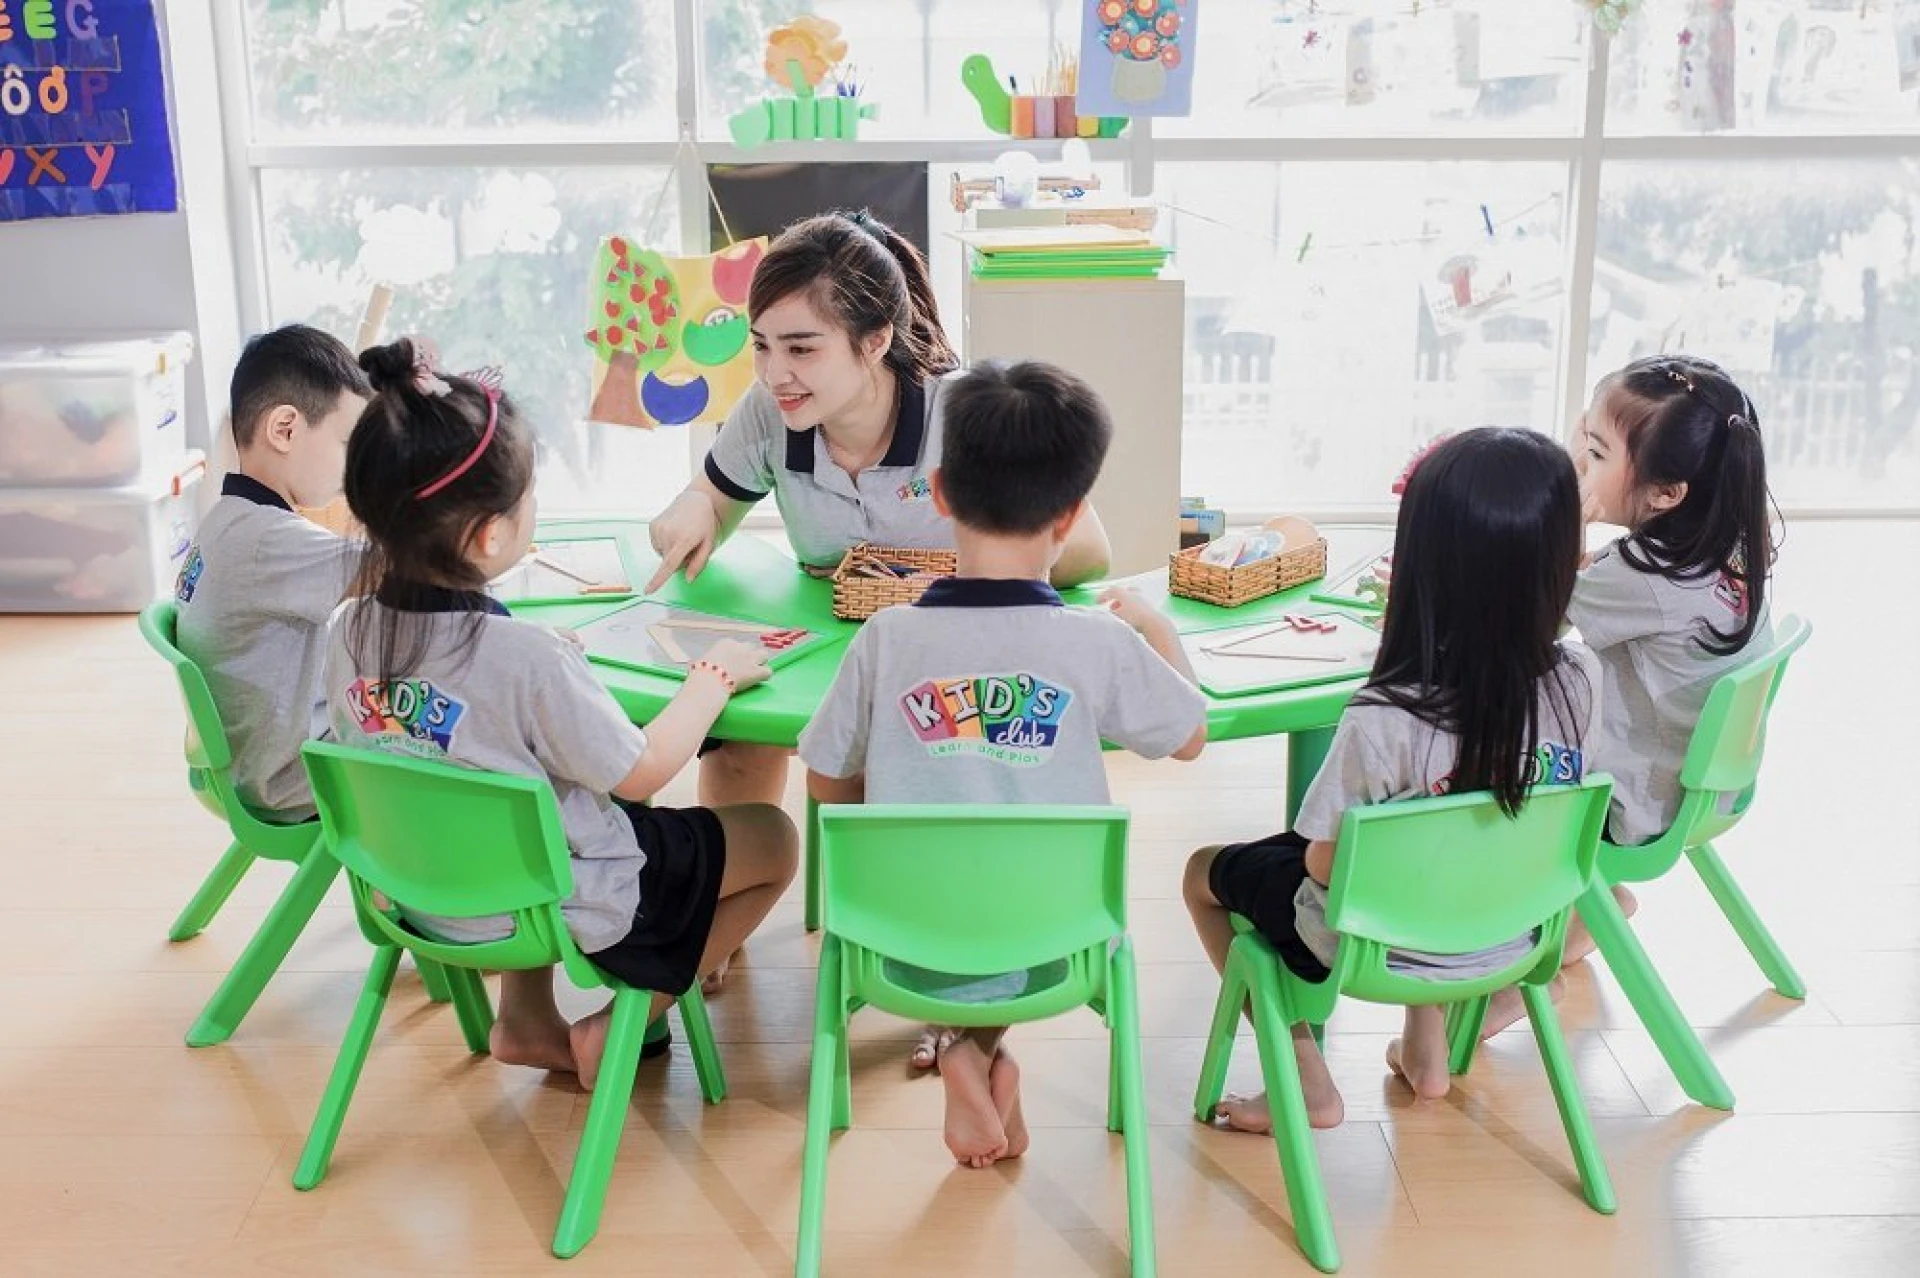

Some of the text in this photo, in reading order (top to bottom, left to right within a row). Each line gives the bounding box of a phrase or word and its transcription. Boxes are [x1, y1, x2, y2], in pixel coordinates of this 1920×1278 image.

[66, 0, 98, 40] G
[904, 674, 1059, 731] KID'S
[995, 717, 1046, 748] club
